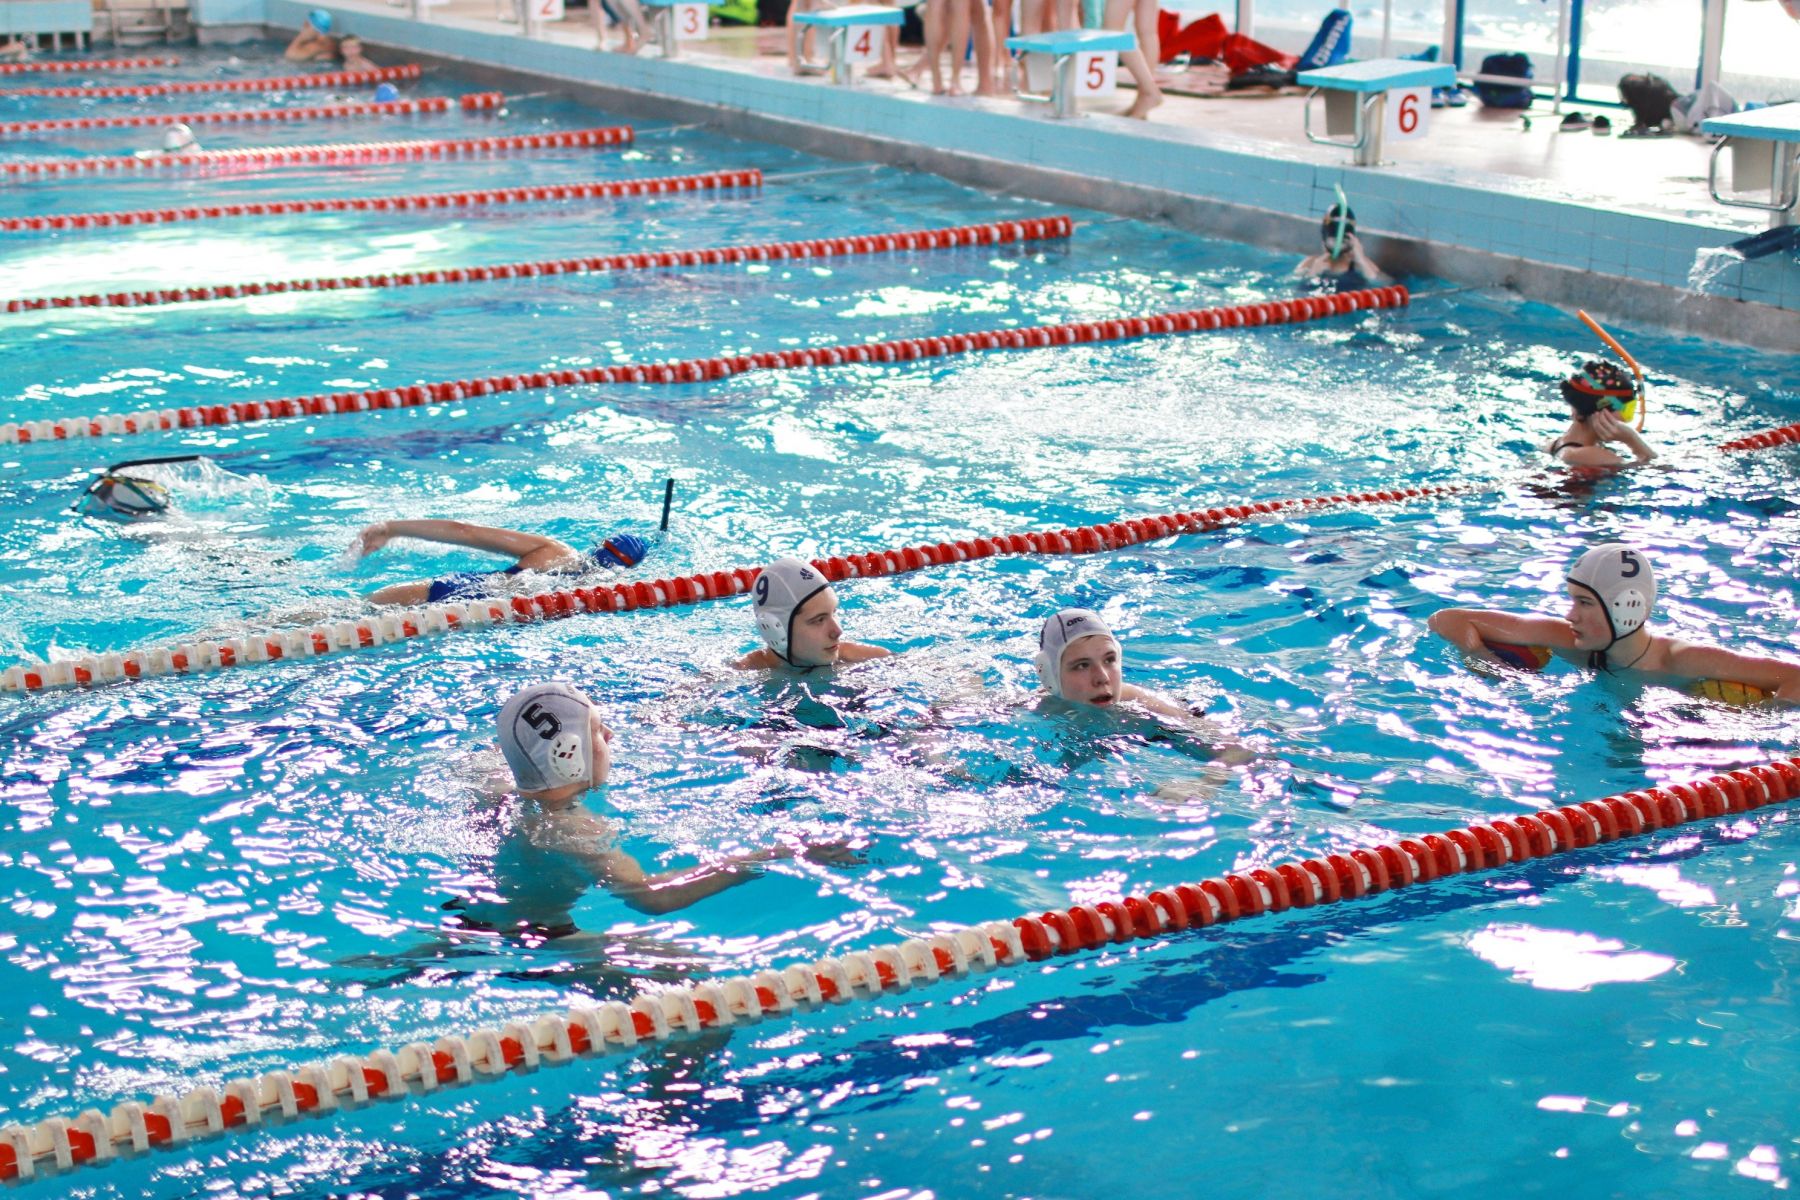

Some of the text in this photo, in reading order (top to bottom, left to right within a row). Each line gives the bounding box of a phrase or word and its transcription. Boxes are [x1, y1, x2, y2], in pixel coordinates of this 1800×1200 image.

[541, 0, 555, 16] 2
[684, 8, 698, 33] 3
[854, 29, 871, 56] 4
[1087, 56, 1104, 90] 5
[1399, 94, 1418, 133] 6
[1621, 551, 1640, 578] 5
[756, 575, 769, 607] 9
[521, 703, 562, 740] 5
